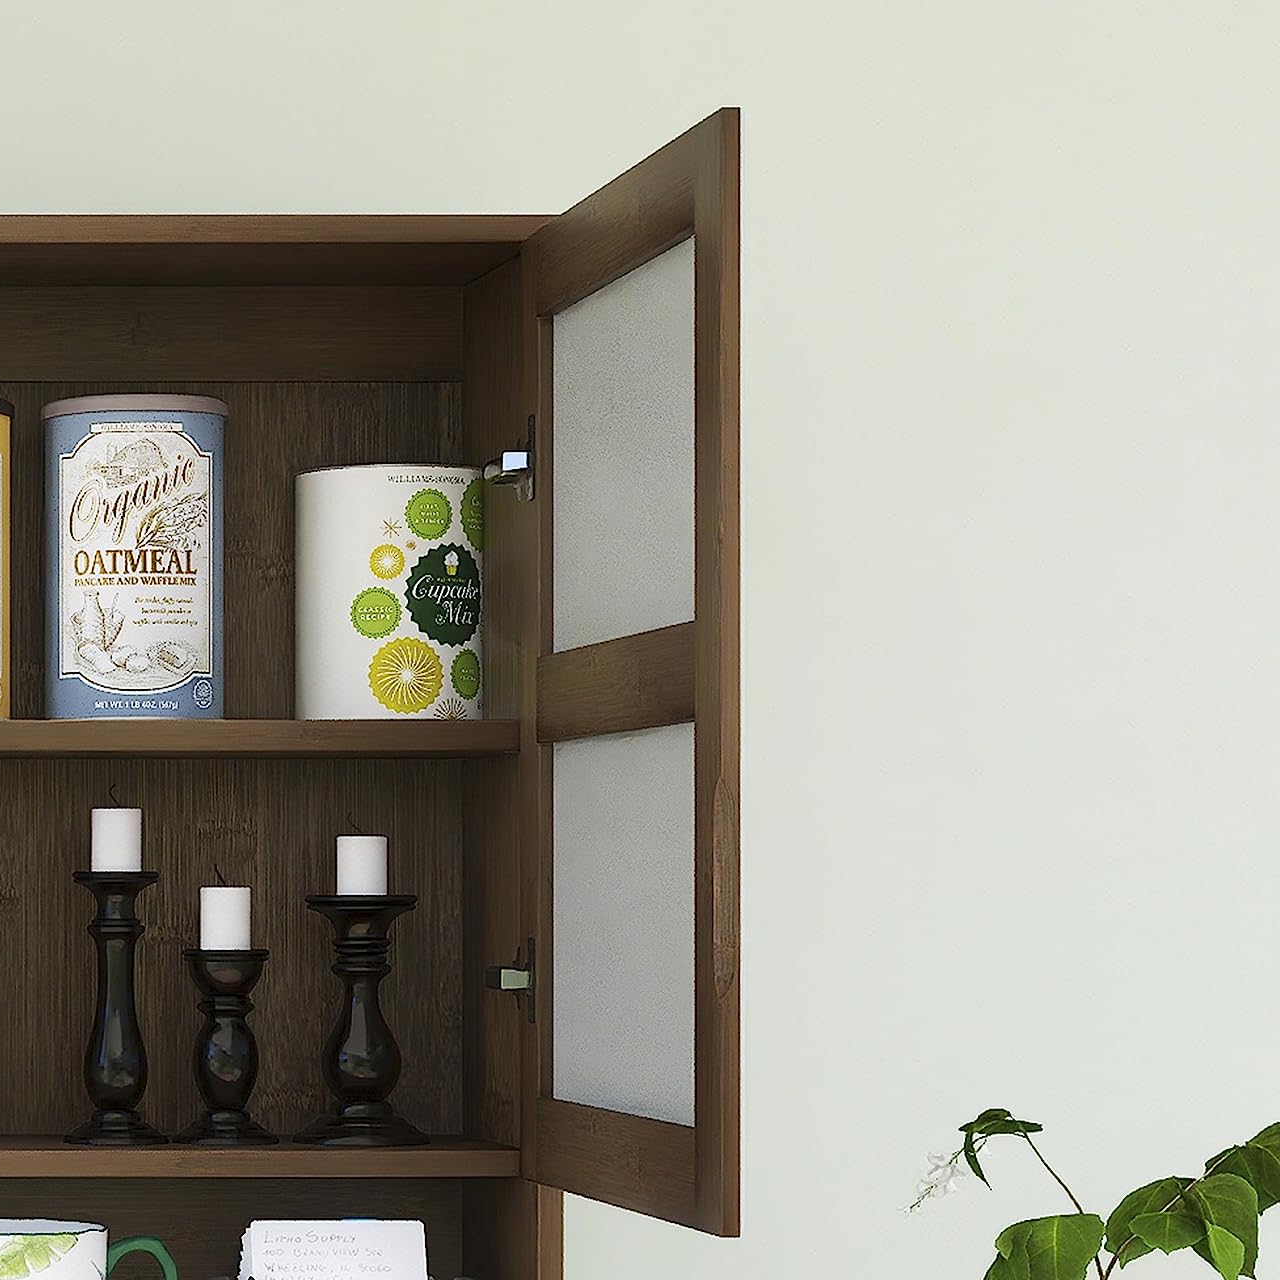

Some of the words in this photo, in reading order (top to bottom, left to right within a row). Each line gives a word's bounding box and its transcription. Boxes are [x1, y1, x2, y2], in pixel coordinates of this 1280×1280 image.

[70, 454, 194, 544] Organic
[74, 550, 198, 574] OATMEAL
[74, 577, 115, 586] PANCAKE
[116, 577, 139, 586] AND
[141, 577, 179, 586] WAFFLE
[180, 577, 197, 586] MIX
[412, 574, 479, 604] Cupcake
[358, 606, 394, 614] CLASSIC
[435, 600, 475, 626] Mix
